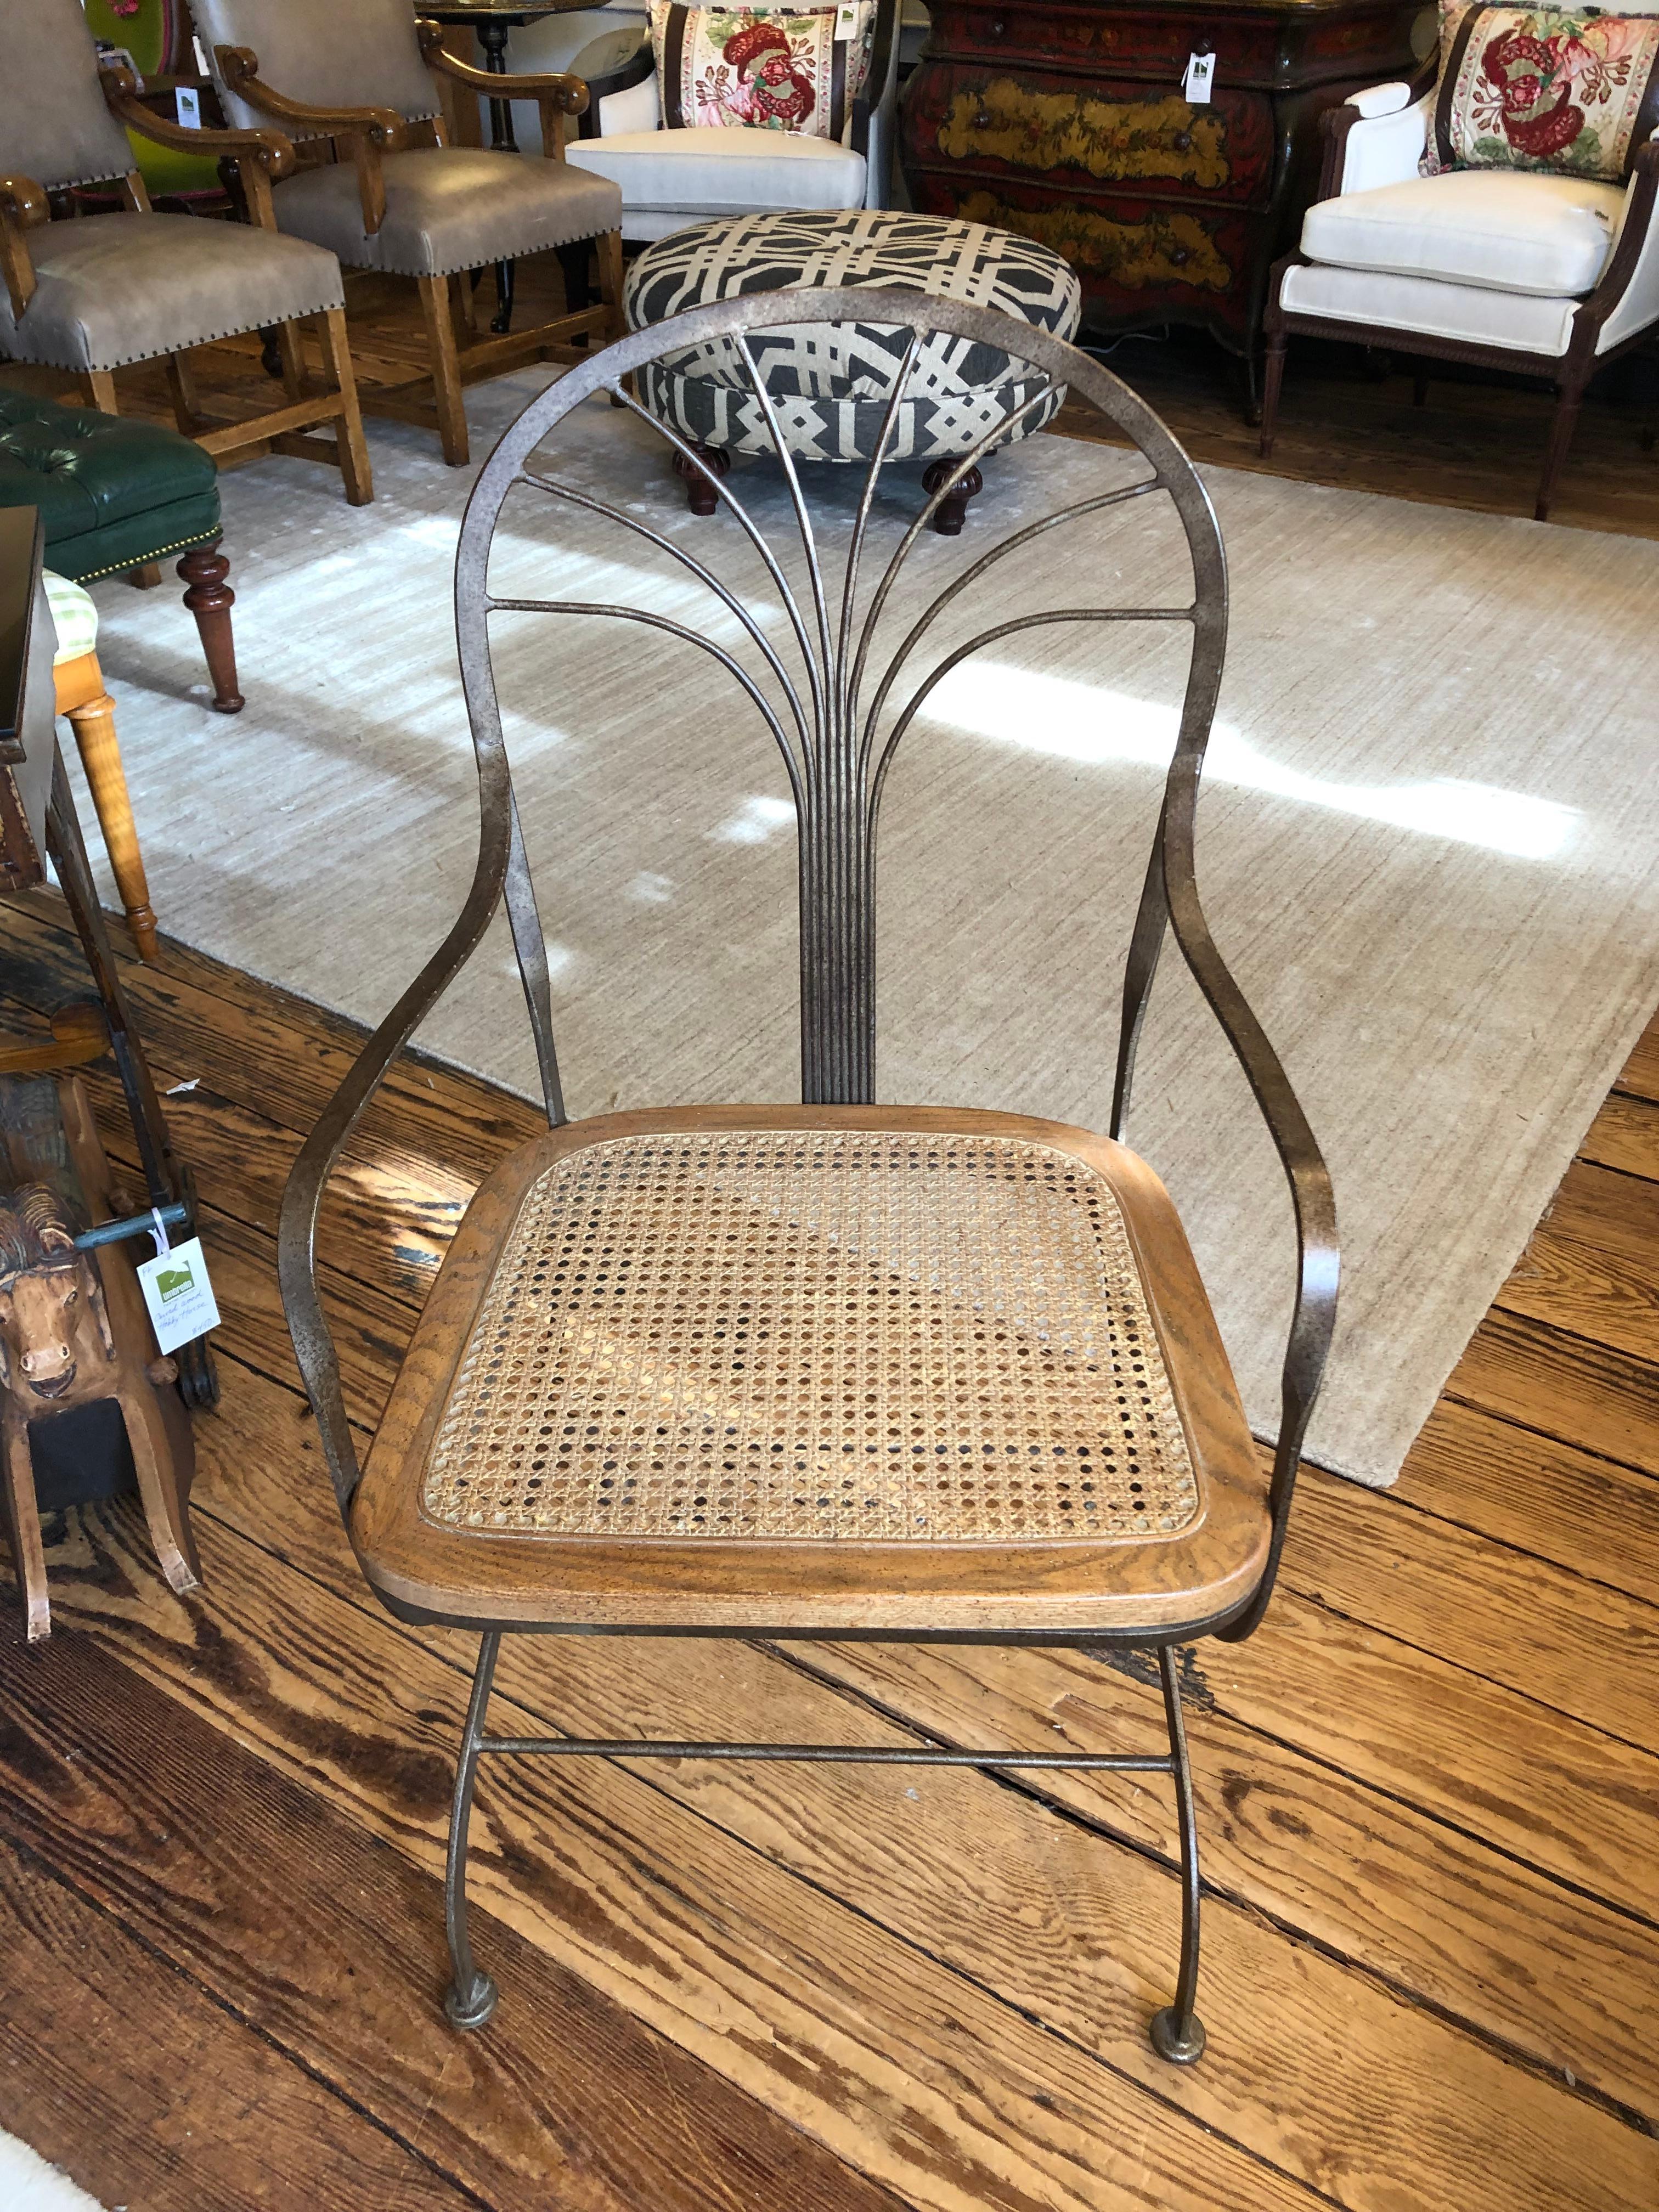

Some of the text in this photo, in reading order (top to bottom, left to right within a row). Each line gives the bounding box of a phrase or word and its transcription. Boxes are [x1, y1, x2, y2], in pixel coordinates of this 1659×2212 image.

[163, 1280, 192, 1301] umbrella
[157, 1301, 207, 1332] Hobby Horse
